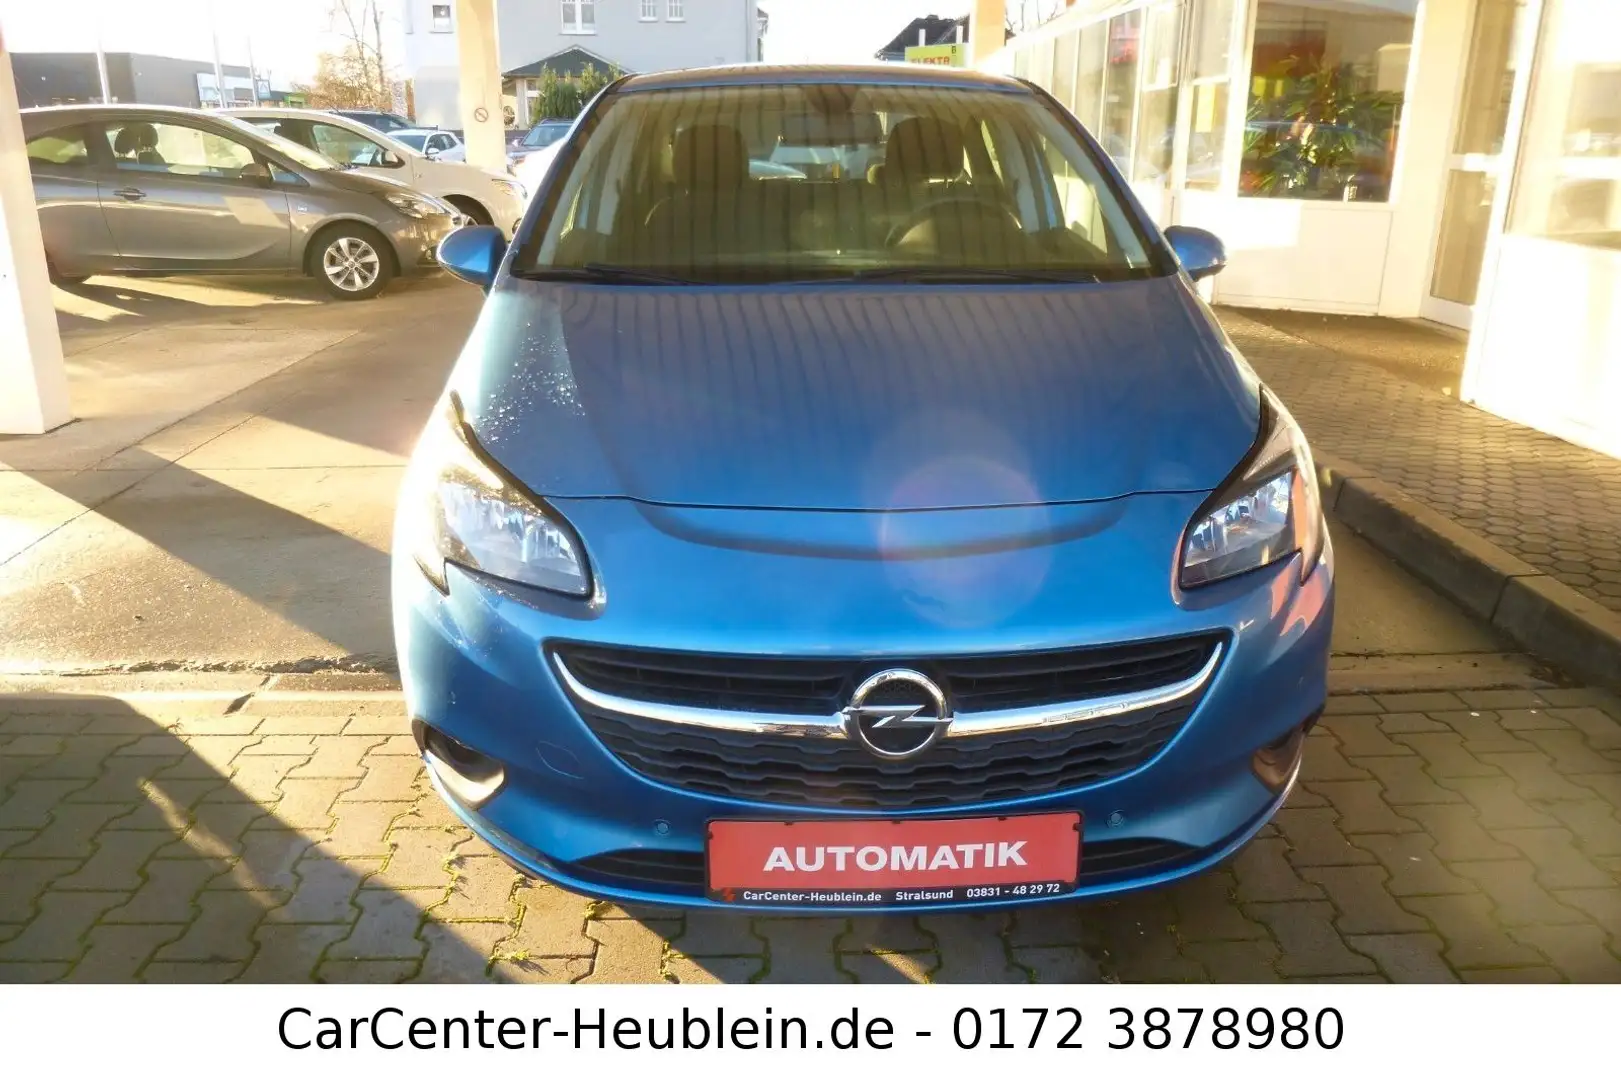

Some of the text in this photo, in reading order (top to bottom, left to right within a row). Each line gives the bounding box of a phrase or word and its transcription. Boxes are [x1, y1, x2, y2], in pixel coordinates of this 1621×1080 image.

[763, 841, 1028, 871] AUTOMATIK
[743, 891, 882, 901] CarCenter-Heublein.de
[895, 890, 953, 900] Stralsund
[966, 887, 1000, 898] 03831
[1012, 885, 1027, 895] 48
[1030, 884, 1044, 894] 29
[1047, 883, 1060, 893] 72
